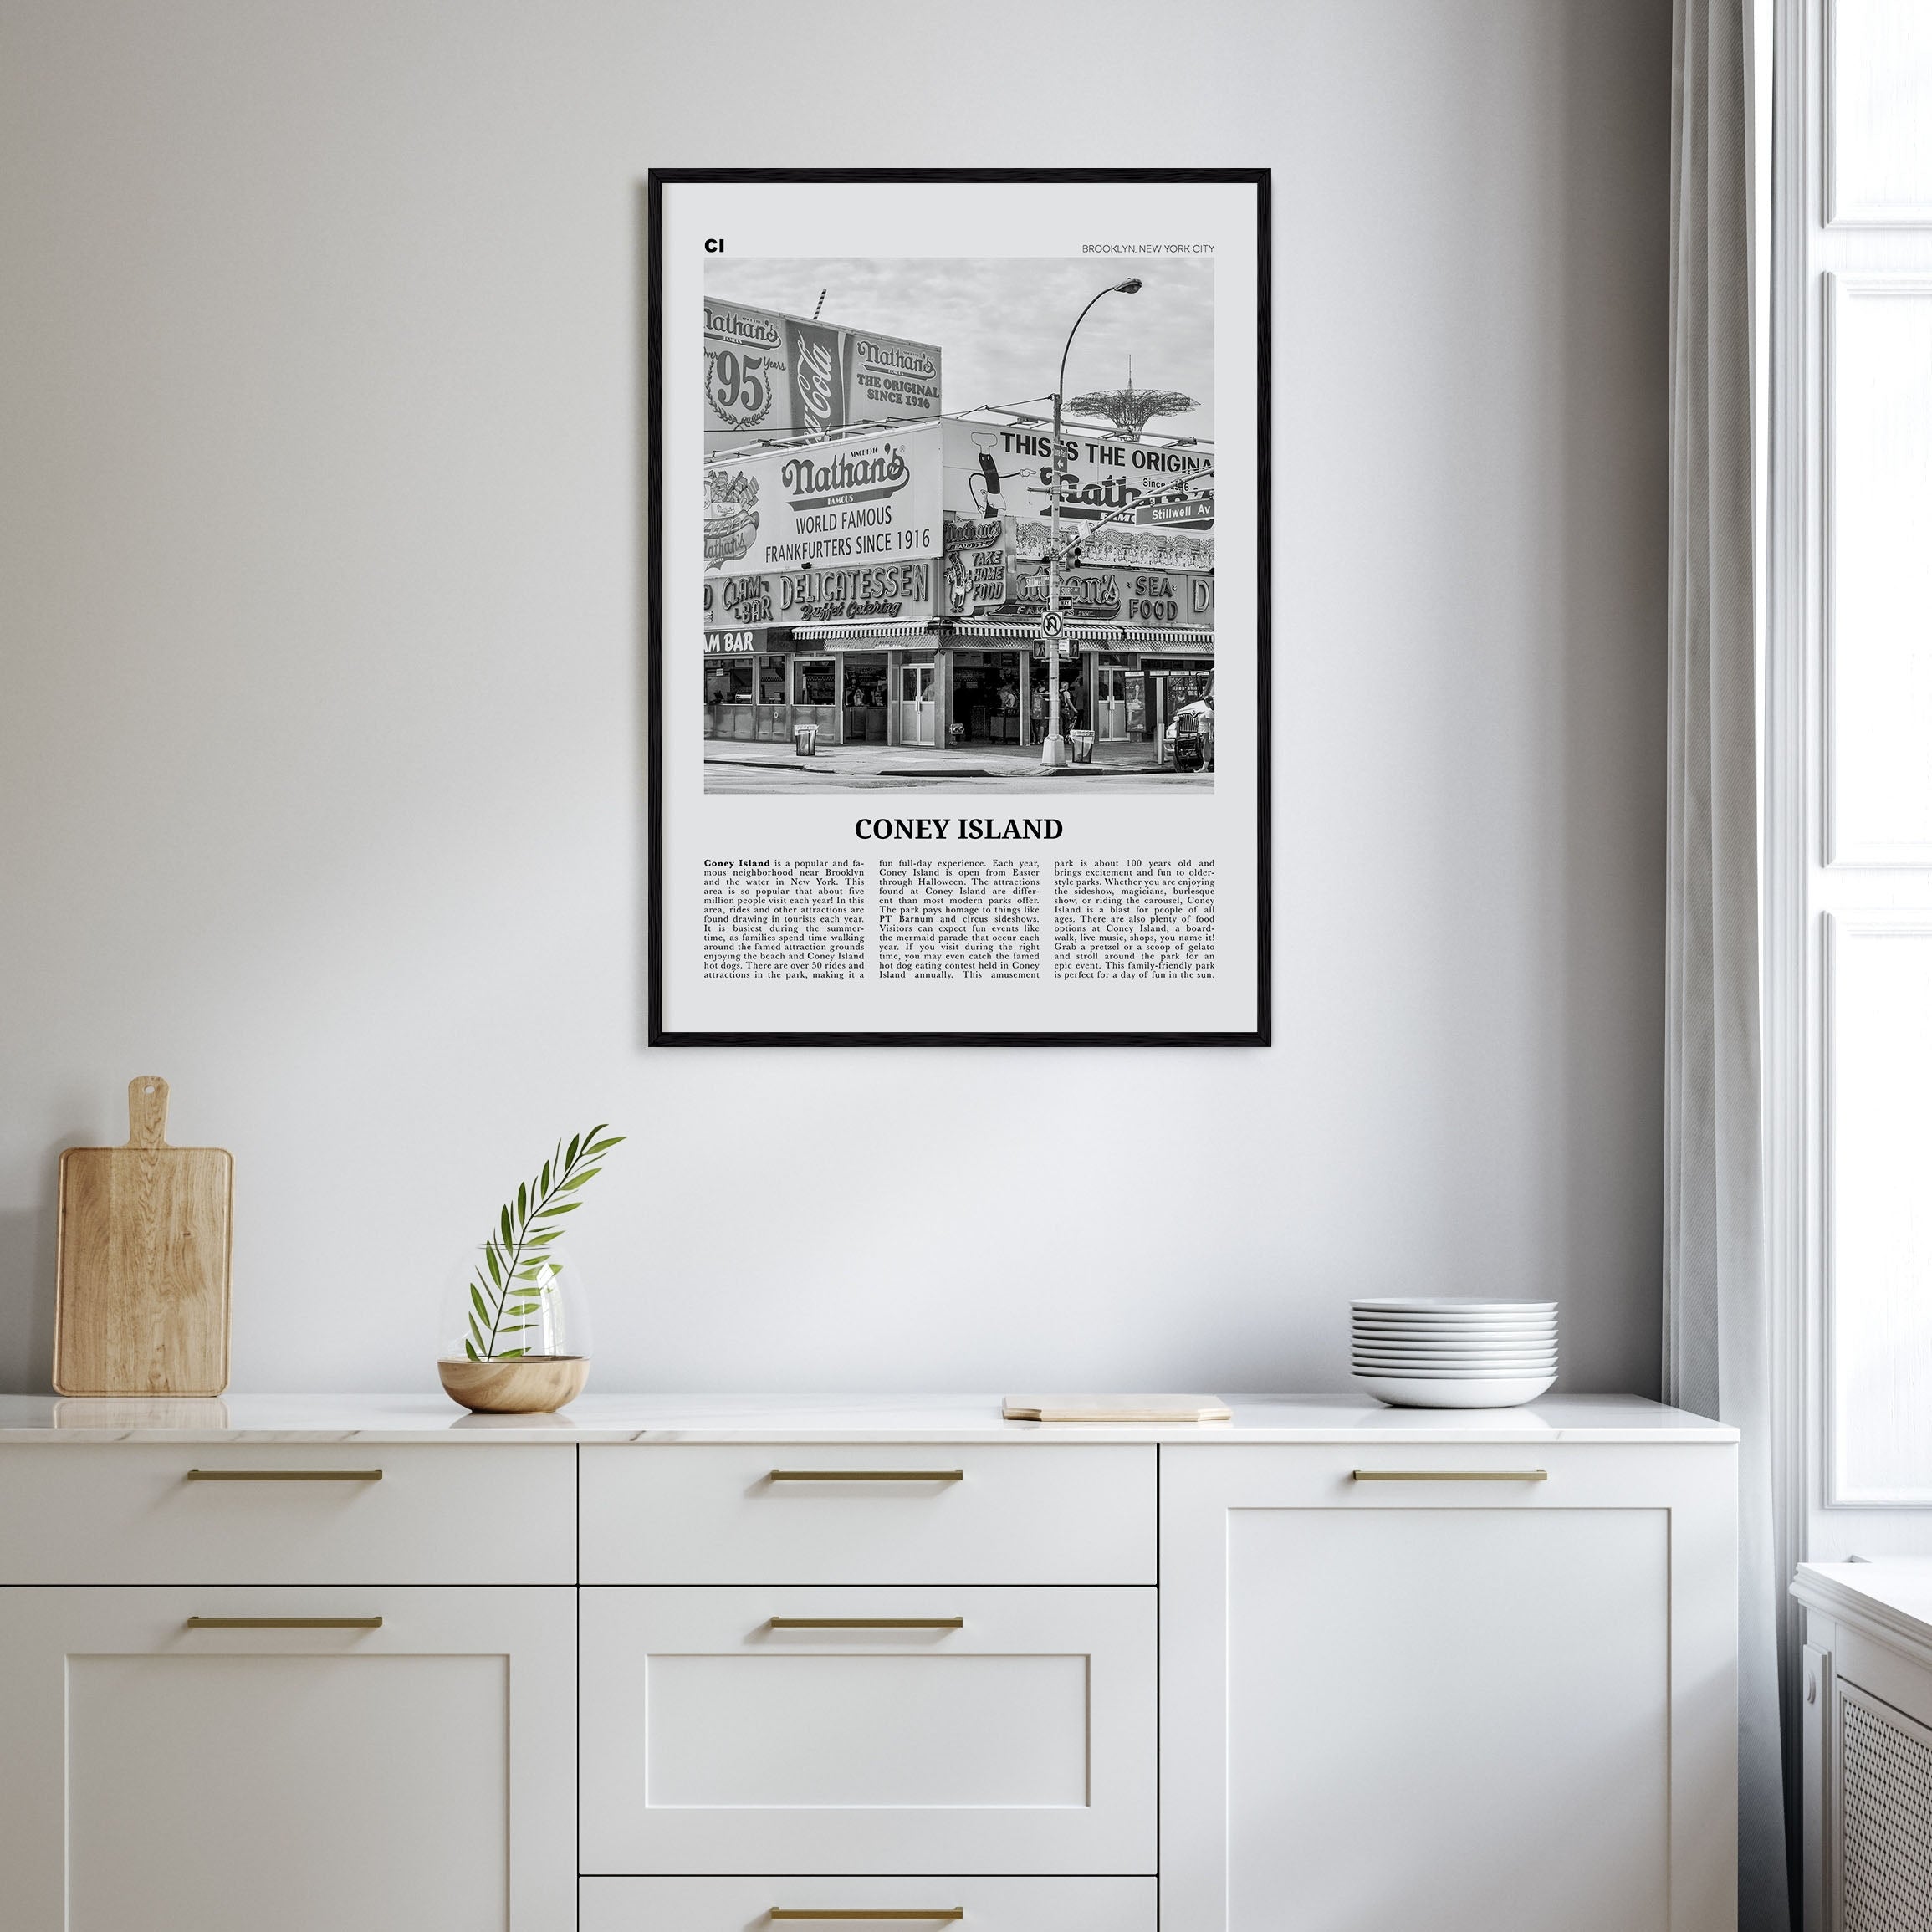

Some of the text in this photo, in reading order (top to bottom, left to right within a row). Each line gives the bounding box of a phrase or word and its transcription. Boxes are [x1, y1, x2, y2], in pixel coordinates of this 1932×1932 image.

[704, 238, 724, 253] CI
[1082, 244, 1215, 254] BROOKLYN, NEW YORK CITY
[857, 340, 933, 374] Nathan's
[716, 350, 764, 411] 95
[856, 373, 940, 399] THE ORIGINAL
[866, 388, 931, 410] SINCE 1916
[1000, 432, 1052, 458] THIS
[1059, 439, 1079, 462] S
[1085, 442, 1126, 468] THE
[781, 442, 906, 496] Nathan's
[1142, 478, 1166, 488] Since
[795, 504, 892, 535] WORLD FAMOUS
[1152, 505, 1192, 520] Stillwell
[1197, 503, 1211, 515] Av
[765, 528, 931, 564] FRANKFURTERS SINCE 1916
[972, 549, 1004, 567] TAKE
[974, 565, 1005, 582] HOME
[722, 575, 761, 611] CLAM
[779, 564, 928, 611] DELICATESSEN
[972, 581, 1004, 601] FOOD
[1136, 575, 1173, 597] SEA
[742, 595, 774, 624] BAR
[800, 599, 902, 621] Buffet Catering
[1129, 598, 1179, 621] FOOD
[723, 631, 754, 652] BAR
[855, 818, 1063, 840] CONEY ISLAND
[704, 860, 734, 870] Coney
[795, 860, 828, 870] popular
[899, 860, 932, 870] full-day
[938, 860, 986, 870] experience.
[1055, 860, 1073, 870] park
[733, 869, 793, 879] neighborhood
[825, 869, 864, 879] Brooklyn
[879, 869, 907, 879] Coney
[1055, 869, 1082, 879] brings
[880, 878, 912, 888] through
[1055, 878, 1073, 888] style
[1076, 878, 1101, 888] parks.
[1178, 878, 1214, 888] enjoying
[756, 887, 790, 897] popular
[926, 887, 953, 897] Coney
[1074, 887, 1114, 897] sideshow,
[1122, 887, 1167, 897] magicians,
[1173, 887, 1214, 897] burlesque
[738, 897, 765, 907] people
[812, 897, 833, 907] year!
[989, 897, 1011, 907] parks
[1055, 897, 1077, 906] show,
[1096, 897, 1122, 907] riding
[1144, 897, 1183, 906] carousel,
[1188, 897, 1214, 907] Coney
